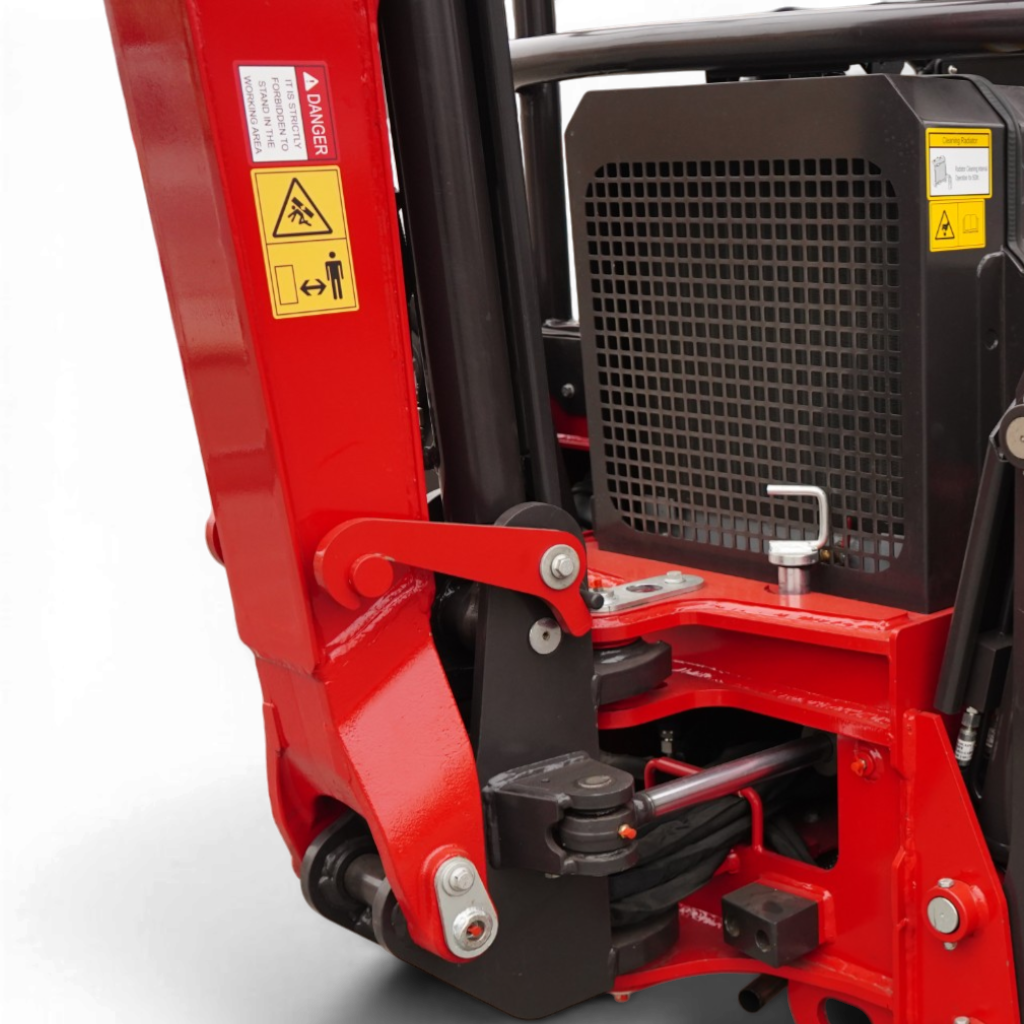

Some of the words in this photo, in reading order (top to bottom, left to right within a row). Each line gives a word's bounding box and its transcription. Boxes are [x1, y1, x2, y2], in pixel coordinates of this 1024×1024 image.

[258, 80, 270, 114] STAND
[285, 78, 294, 87] IT
[286, 90, 295, 100] IS
[243, 76, 258, 125] WORKING
[251, 127, 263, 155] AREA
[263, 116, 272, 127] IN
[271, 77, 287, 136] FORBIDDEN
[280, 138, 289, 152] TO
[288, 102, 302, 150] STRICTLY
[306, 94, 329, 155] DANGER
[265, 128, 275, 149] THE
